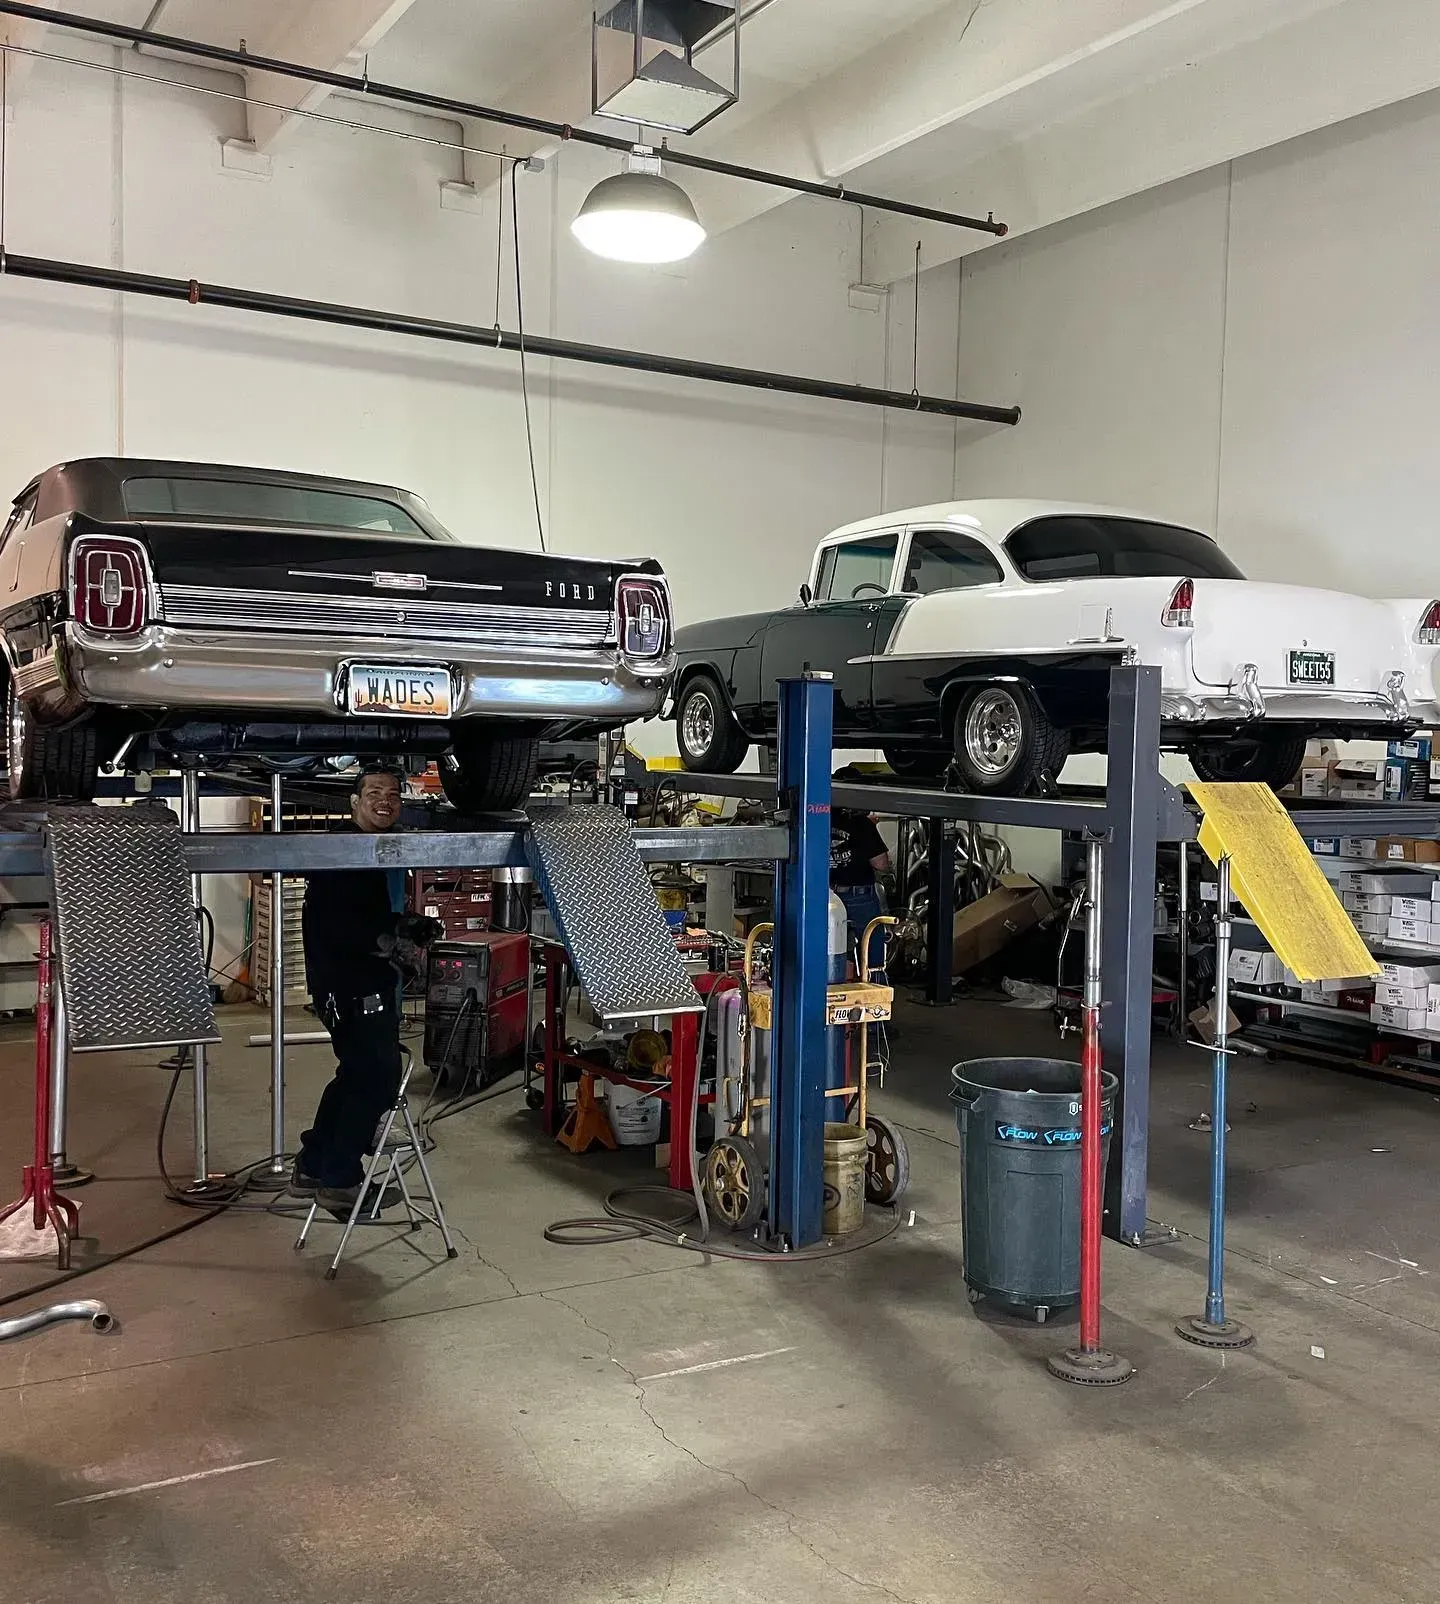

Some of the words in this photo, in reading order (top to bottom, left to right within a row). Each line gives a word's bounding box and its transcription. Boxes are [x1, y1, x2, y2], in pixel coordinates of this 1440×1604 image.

[544, 580, 595, 600] FORD
[1292, 660, 1331, 679] SWEET55
[367, 677, 435, 705] WADES
[1006, 1126, 1038, 1140] FLOW
